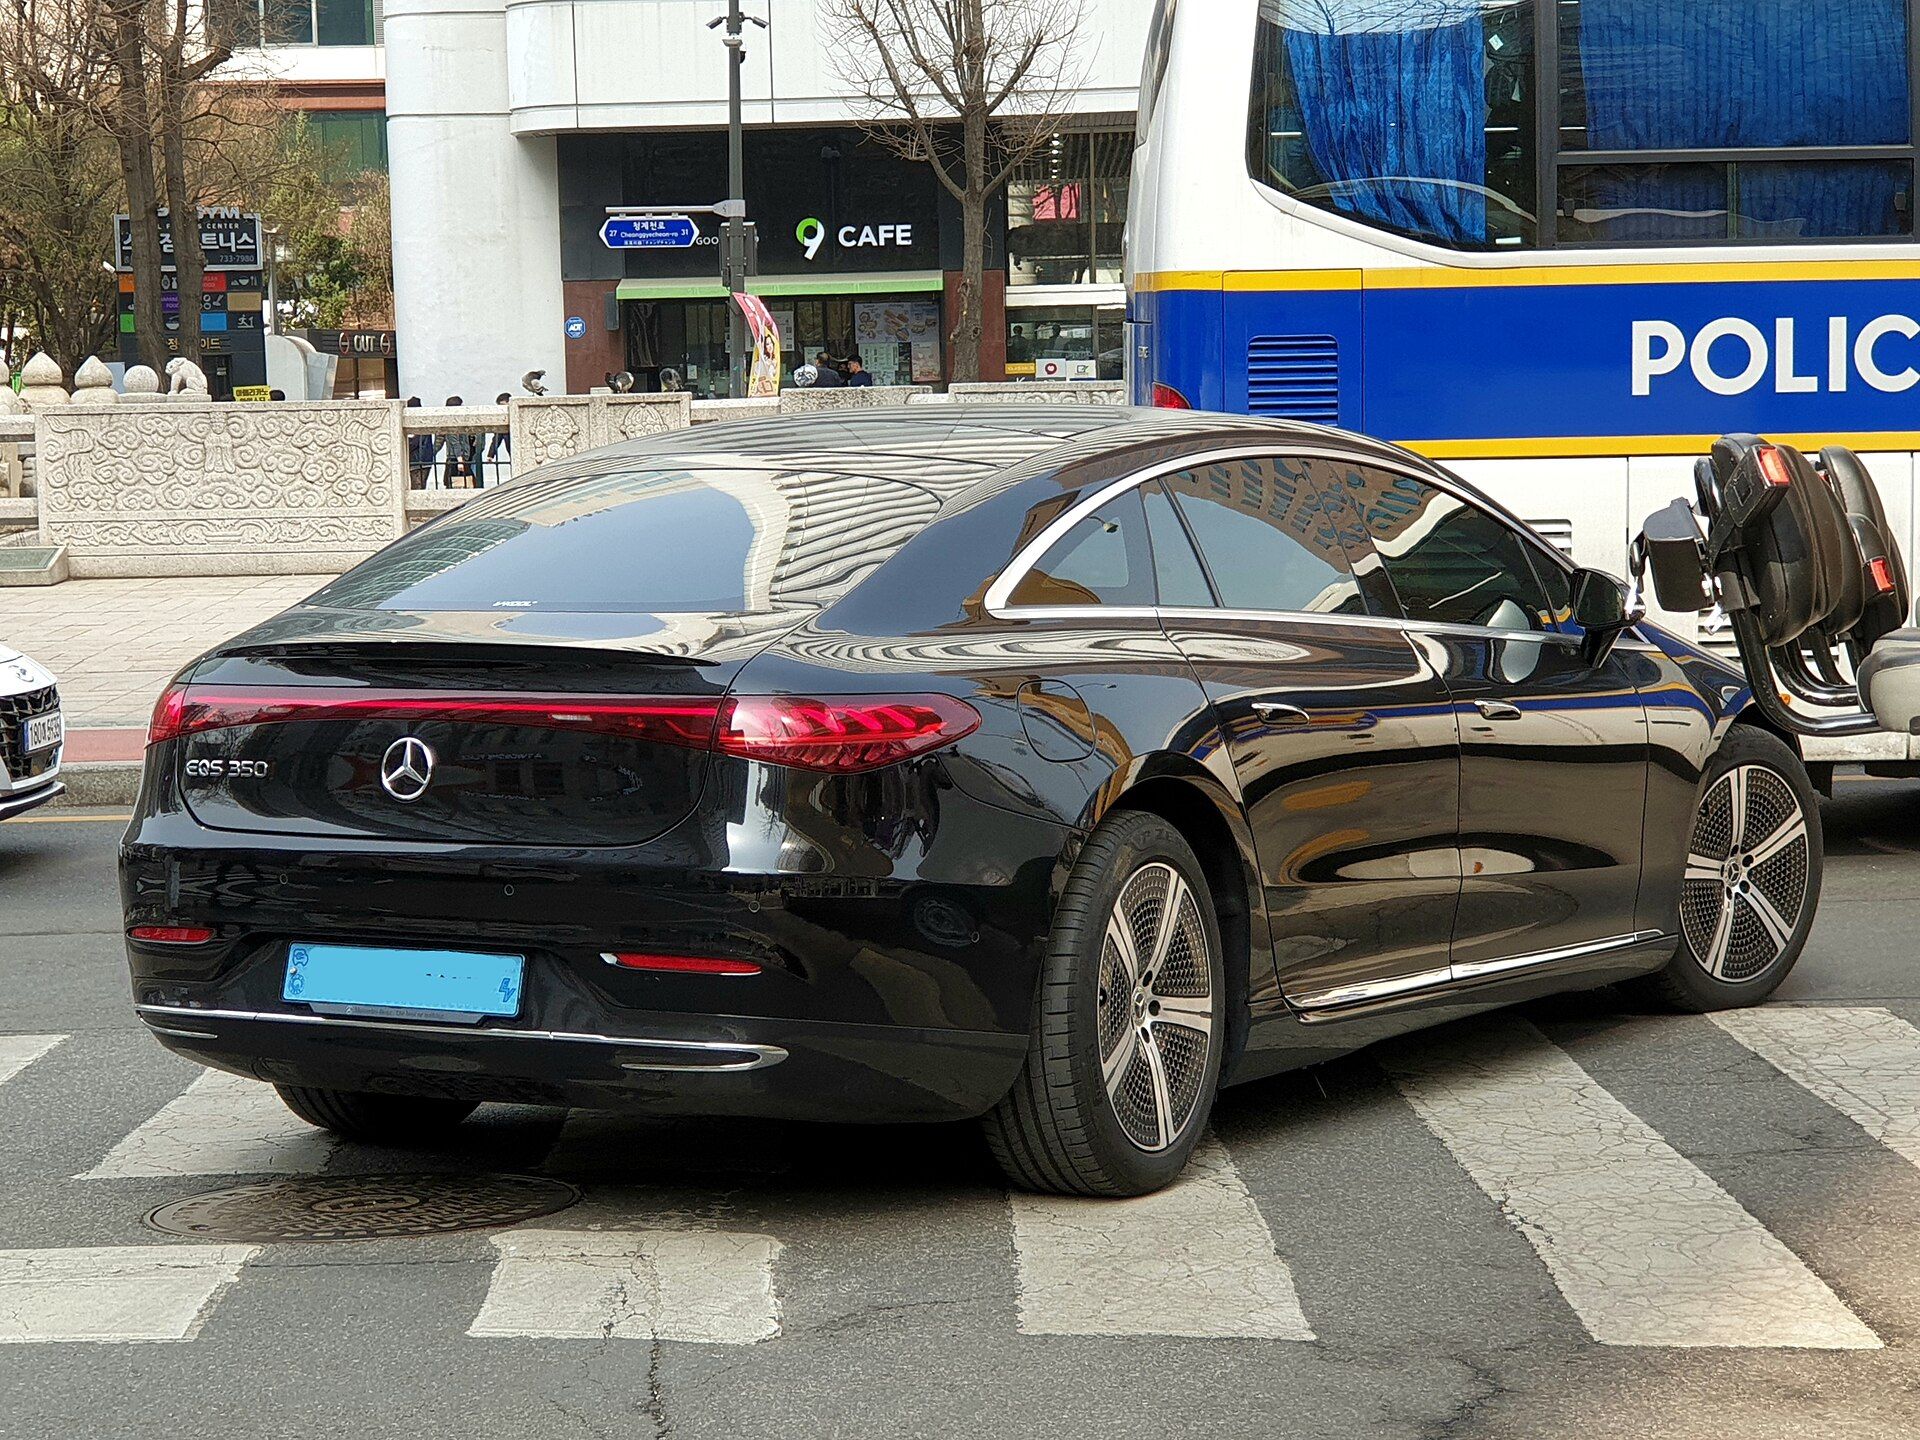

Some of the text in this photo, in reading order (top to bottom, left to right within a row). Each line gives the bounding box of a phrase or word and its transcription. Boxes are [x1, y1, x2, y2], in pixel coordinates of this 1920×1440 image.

[206, 222, 239, 230] CENTER
[632, 221, 666, 231] 청계천로
[608, 229, 618, 237] 27
[620, 231, 679, 239] Cheonggyecheon-ro
[681, 228, 689, 236] 31
[838, 224, 912, 248] CAFE
[354, 334, 376, 352] OUT
[1631, 314, 1920, 396] POLIC
[186, 759, 269, 778] EQS 350
